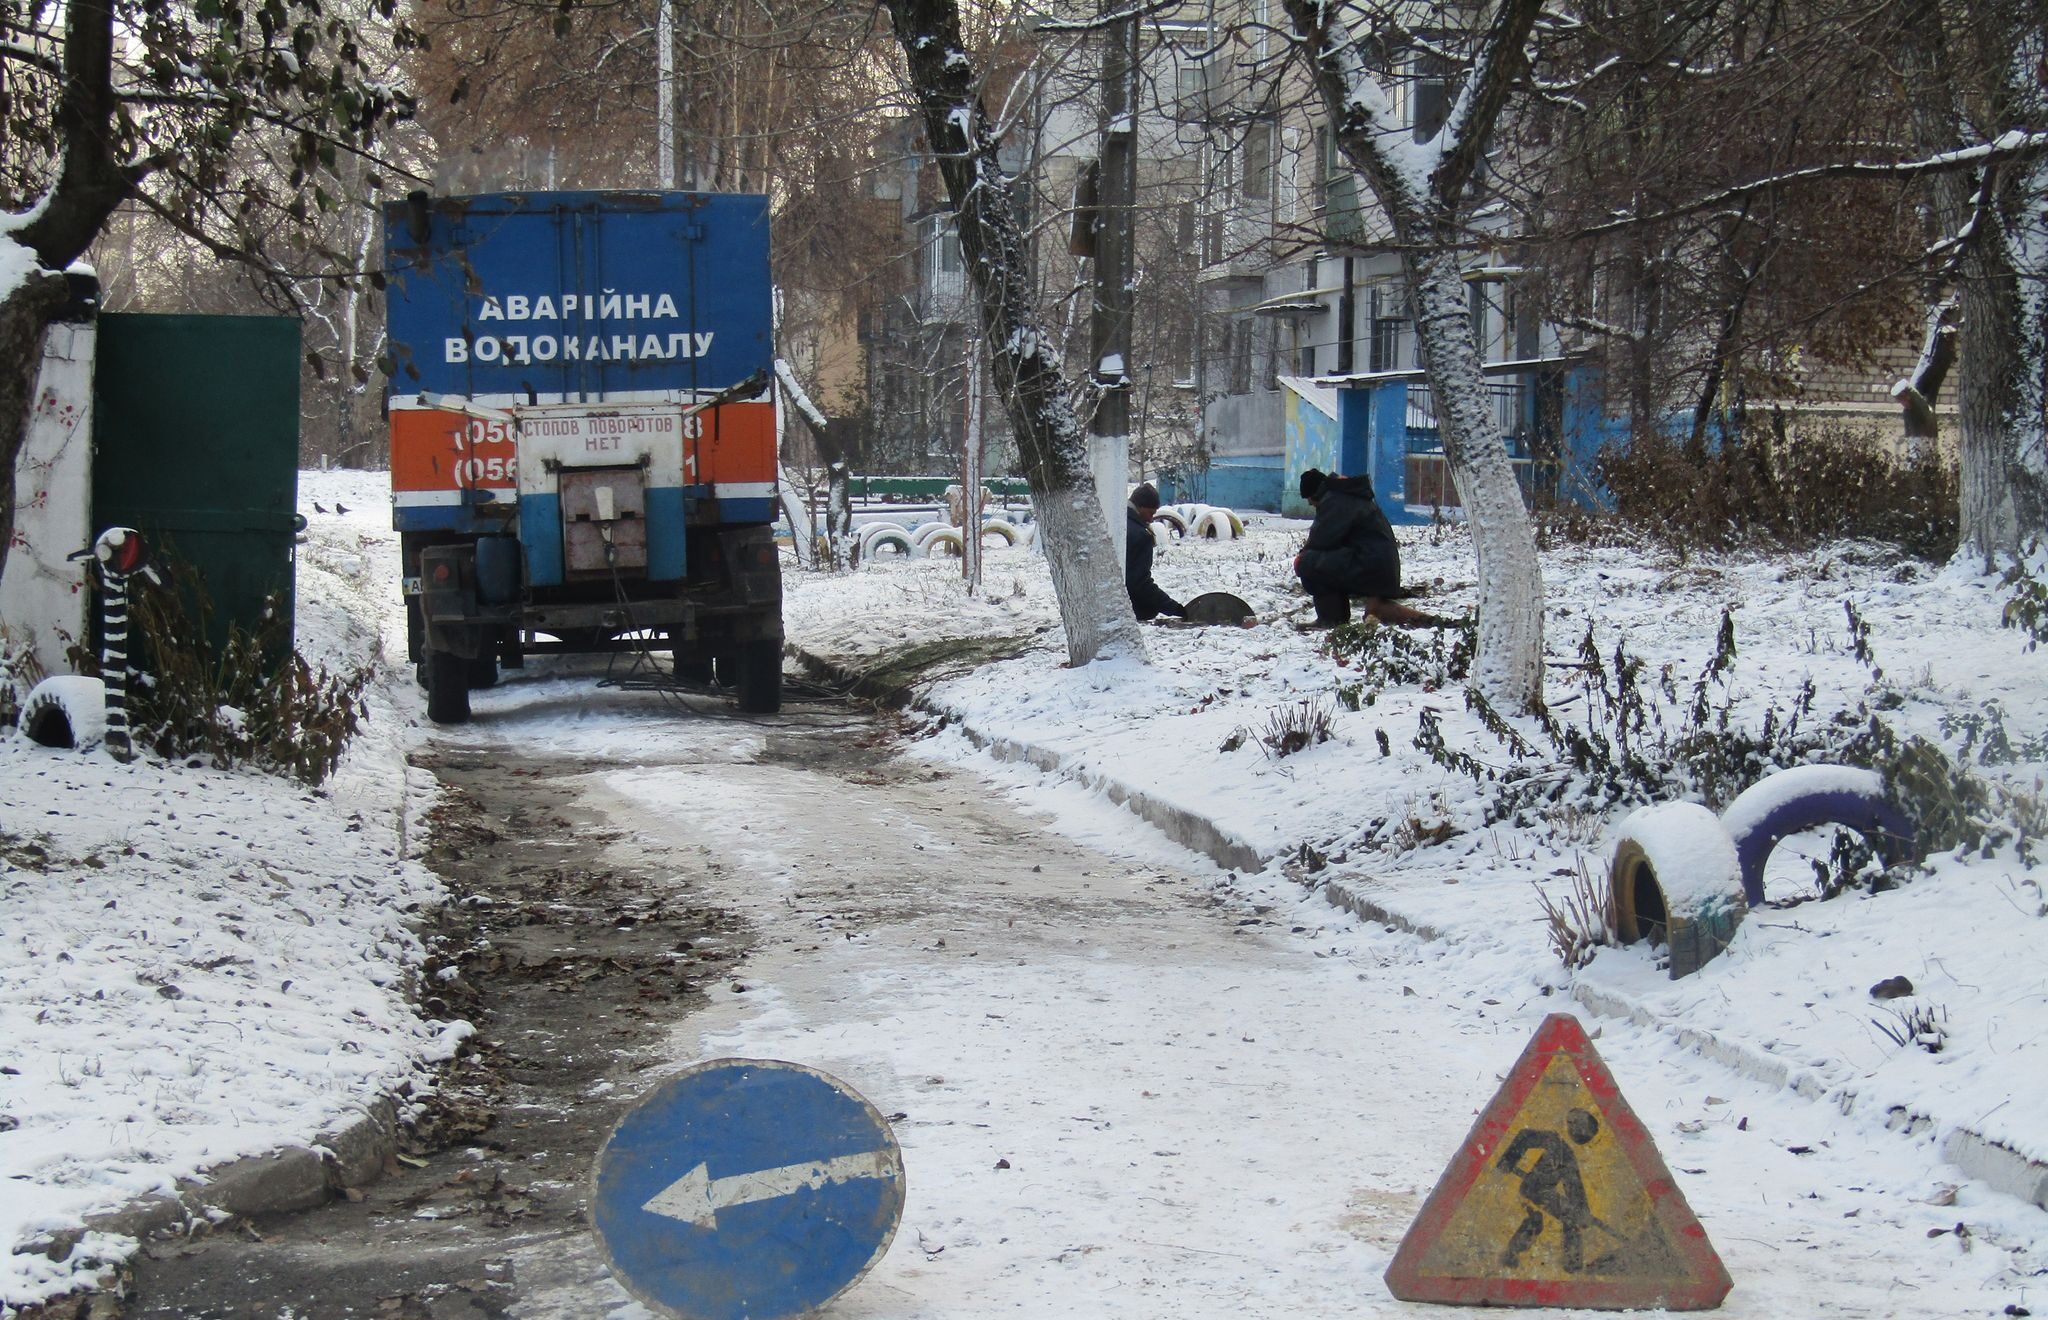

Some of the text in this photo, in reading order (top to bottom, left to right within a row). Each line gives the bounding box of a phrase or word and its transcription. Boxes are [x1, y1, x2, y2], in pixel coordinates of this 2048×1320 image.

[478, 288, 679, 321] АВАРІЙНА
[445, 332, 715, 367] ВОДОКАНАЛУ
[524, 417, 673, 437] СТОПОВ ПОВОРОТОВ
[585, 436, 622, 451] НЕТ
